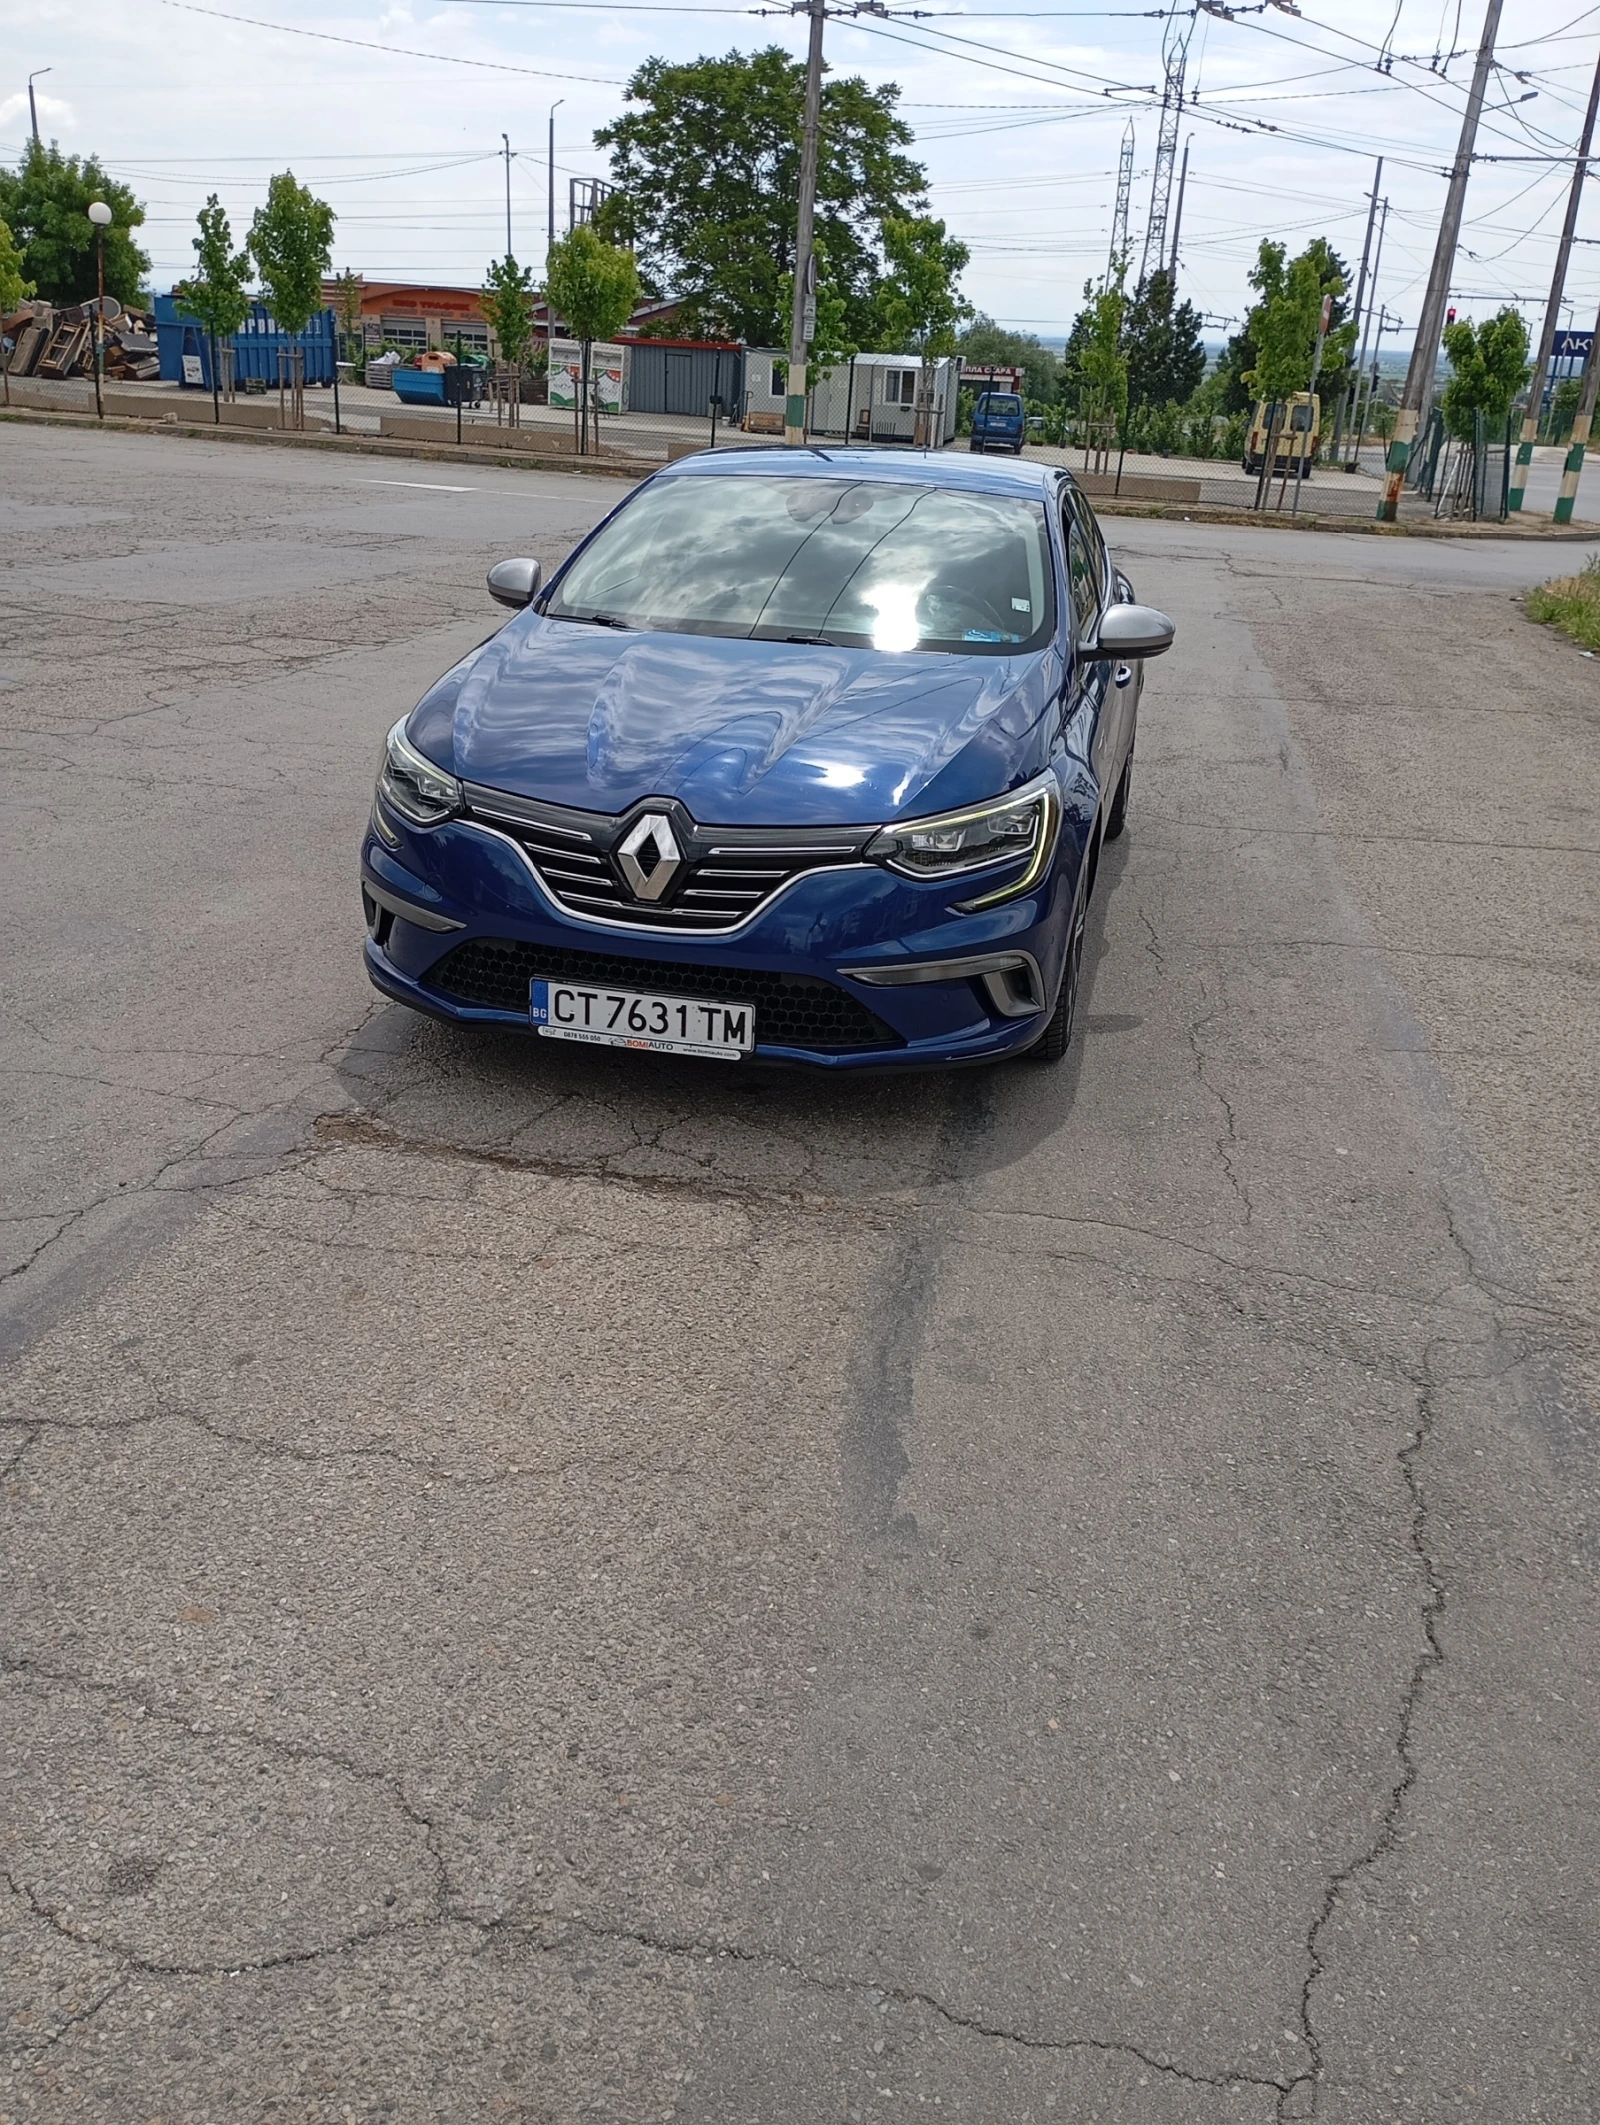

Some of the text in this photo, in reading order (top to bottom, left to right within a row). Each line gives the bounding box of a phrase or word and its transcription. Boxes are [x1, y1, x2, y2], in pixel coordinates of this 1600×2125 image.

[1560, 337, 1594, 351] АК
[965, 366, 982, 374] ПЛА
[983, 367, 1012, 375] САРА
[532, 1007, 547, 1019] BG
[554, 989, 746, 1045] CT 7631 TM
[563, 1031, 578, 1039] 0878
[626, 1039, 674, 1051] BOMIAUTO
